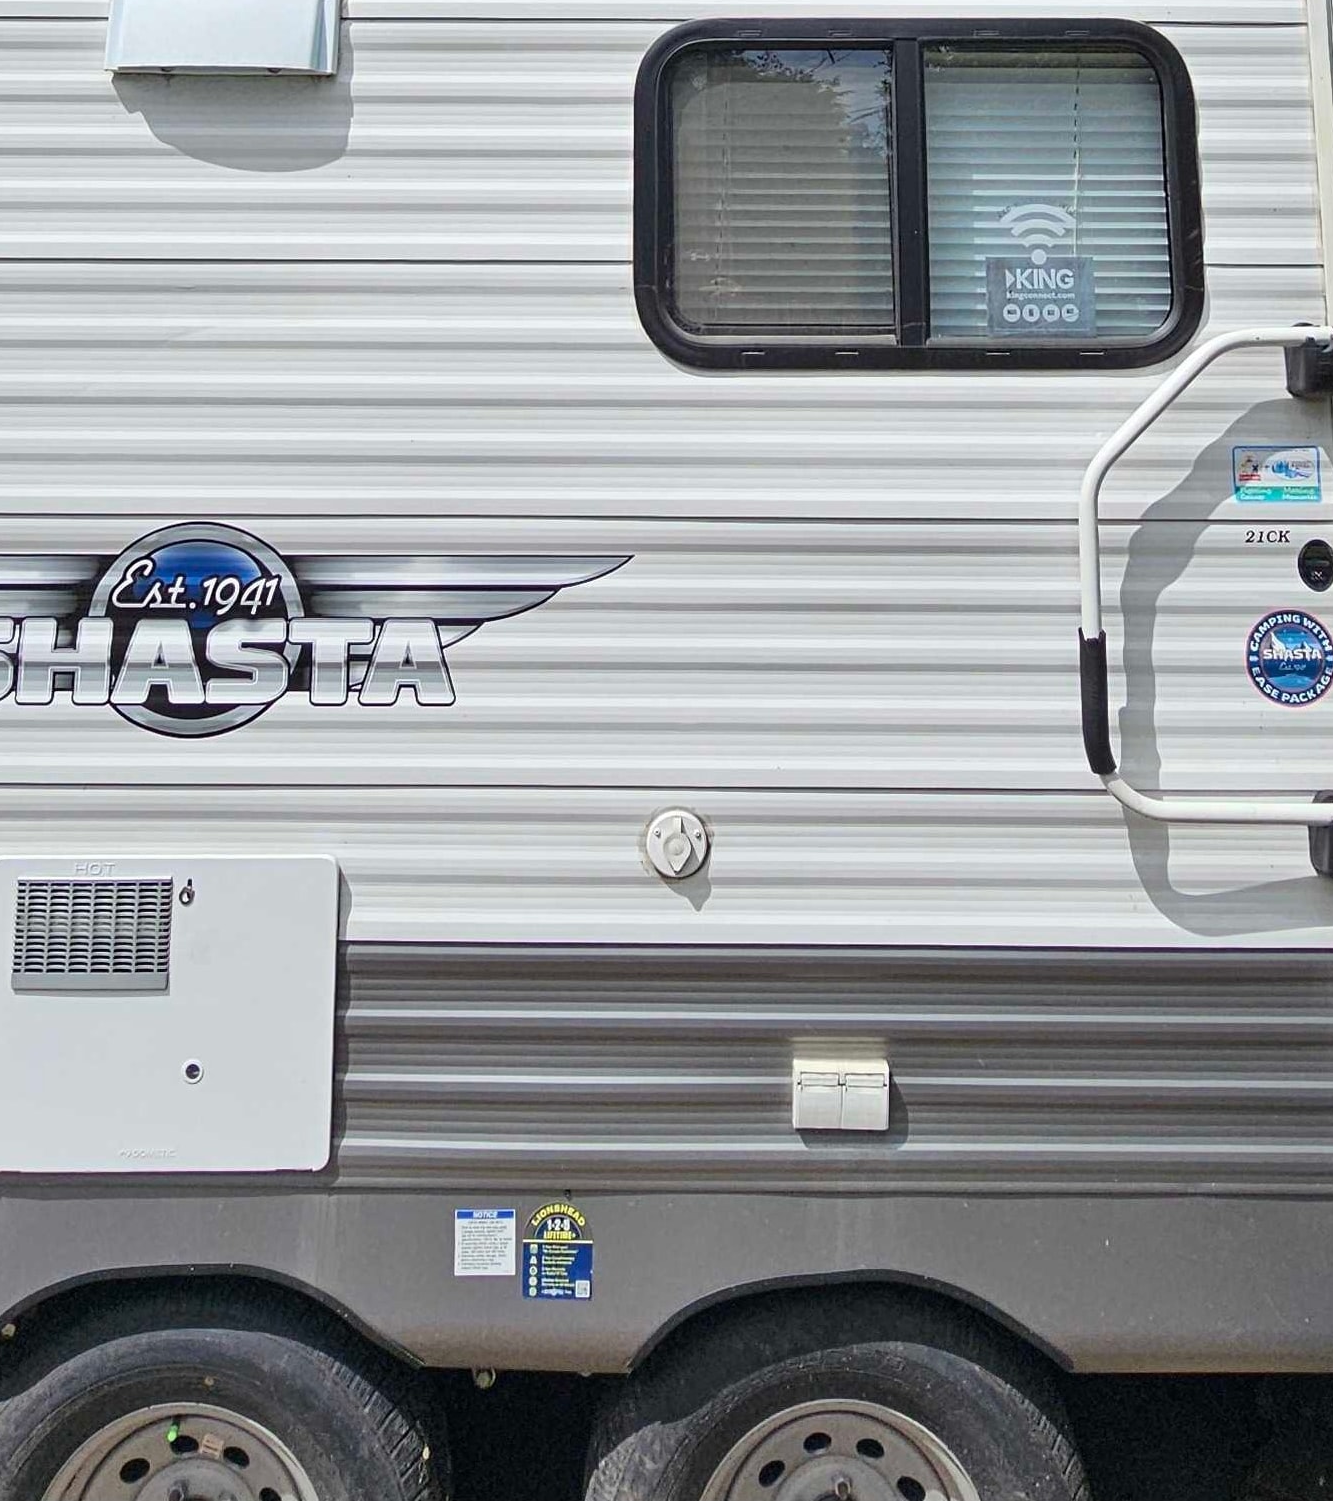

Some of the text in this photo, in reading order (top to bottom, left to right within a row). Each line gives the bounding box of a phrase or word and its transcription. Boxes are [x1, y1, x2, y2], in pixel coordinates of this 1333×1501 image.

[1016, 268, 1075, 289] KING
[1006, 291, 1076, 301] kingconnect.com
[1244, 530, 1291, 544] 21CK
[111, 558, 280, 616] Est. 1941
[1250, 613, 1333, 652] CAMPING WITH
[1263, 648, 1322, 662] SHASTA
[1251, 666, 1333, 704] EASE PACKAGE
[75, 862, 116, 877] HOT
[473, 1210, 498, 1219] NOTICE
[531, 1203, 586, 1227] LIONSHEAD
